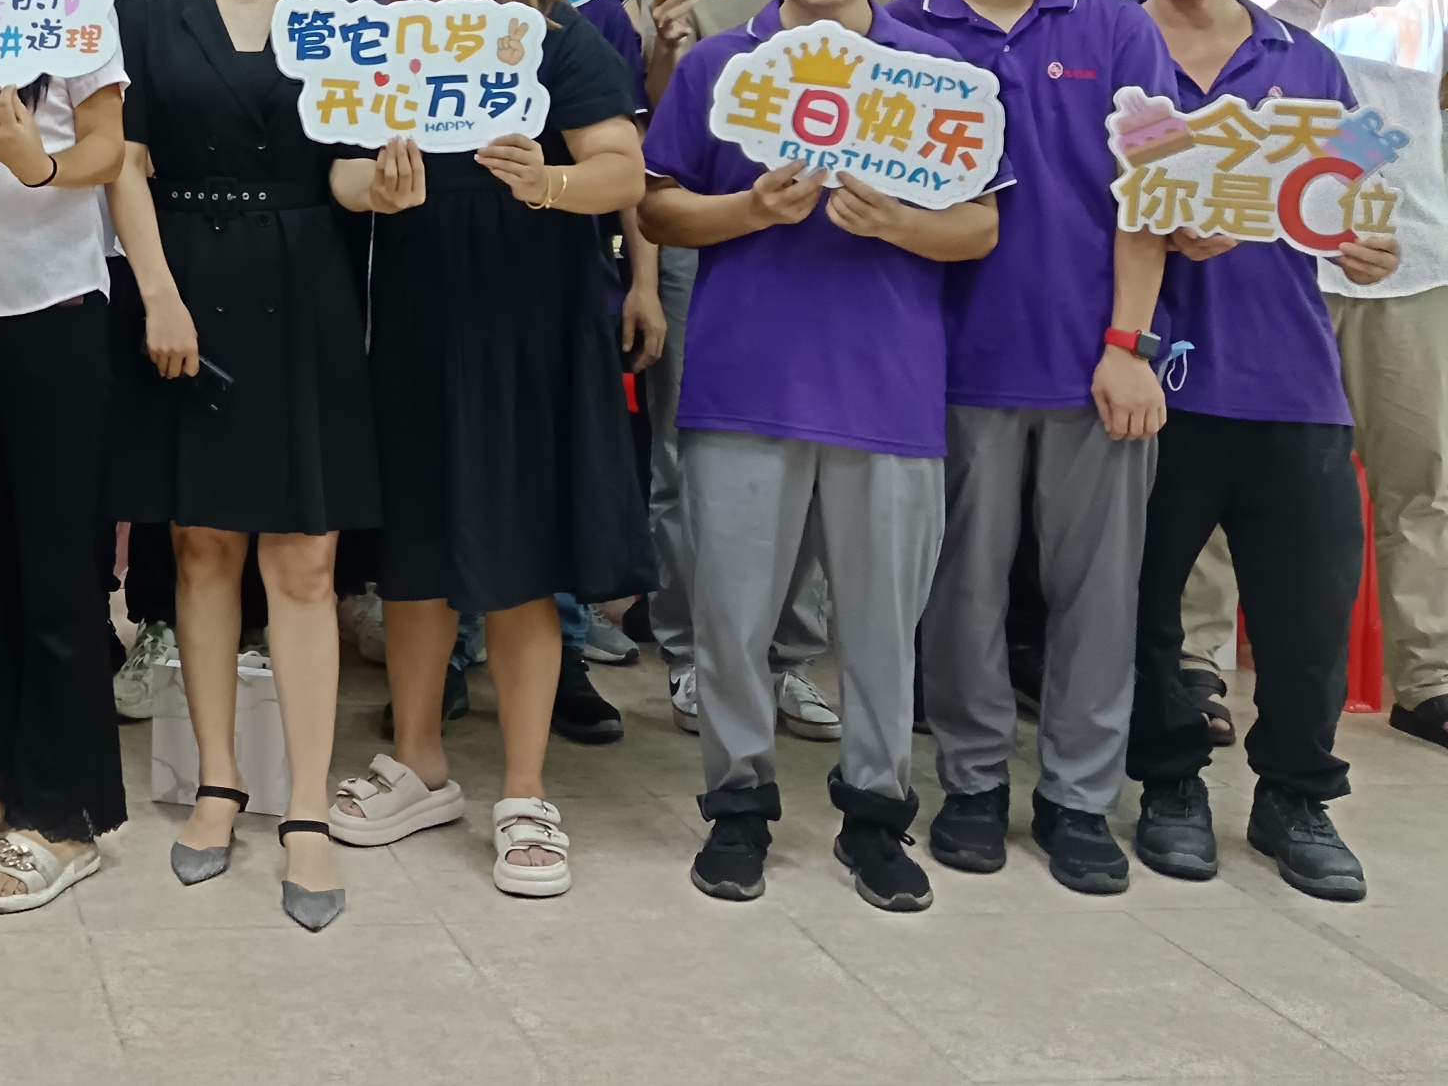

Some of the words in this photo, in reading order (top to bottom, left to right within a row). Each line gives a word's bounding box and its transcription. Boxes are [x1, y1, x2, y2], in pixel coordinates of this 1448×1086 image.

[287, 9, 488, 65] 管它几岁
[870, 63, 979, 100] HAPPY
[424, 120, 476, 134] HAPPY
[726, 69, 985, 172] 生日快乐
[1186, 101, 1343, 172] 今天
[778, 140, 952, 192] BIRTHDAY
[1119, 156, 1398, 251] 你是C位
